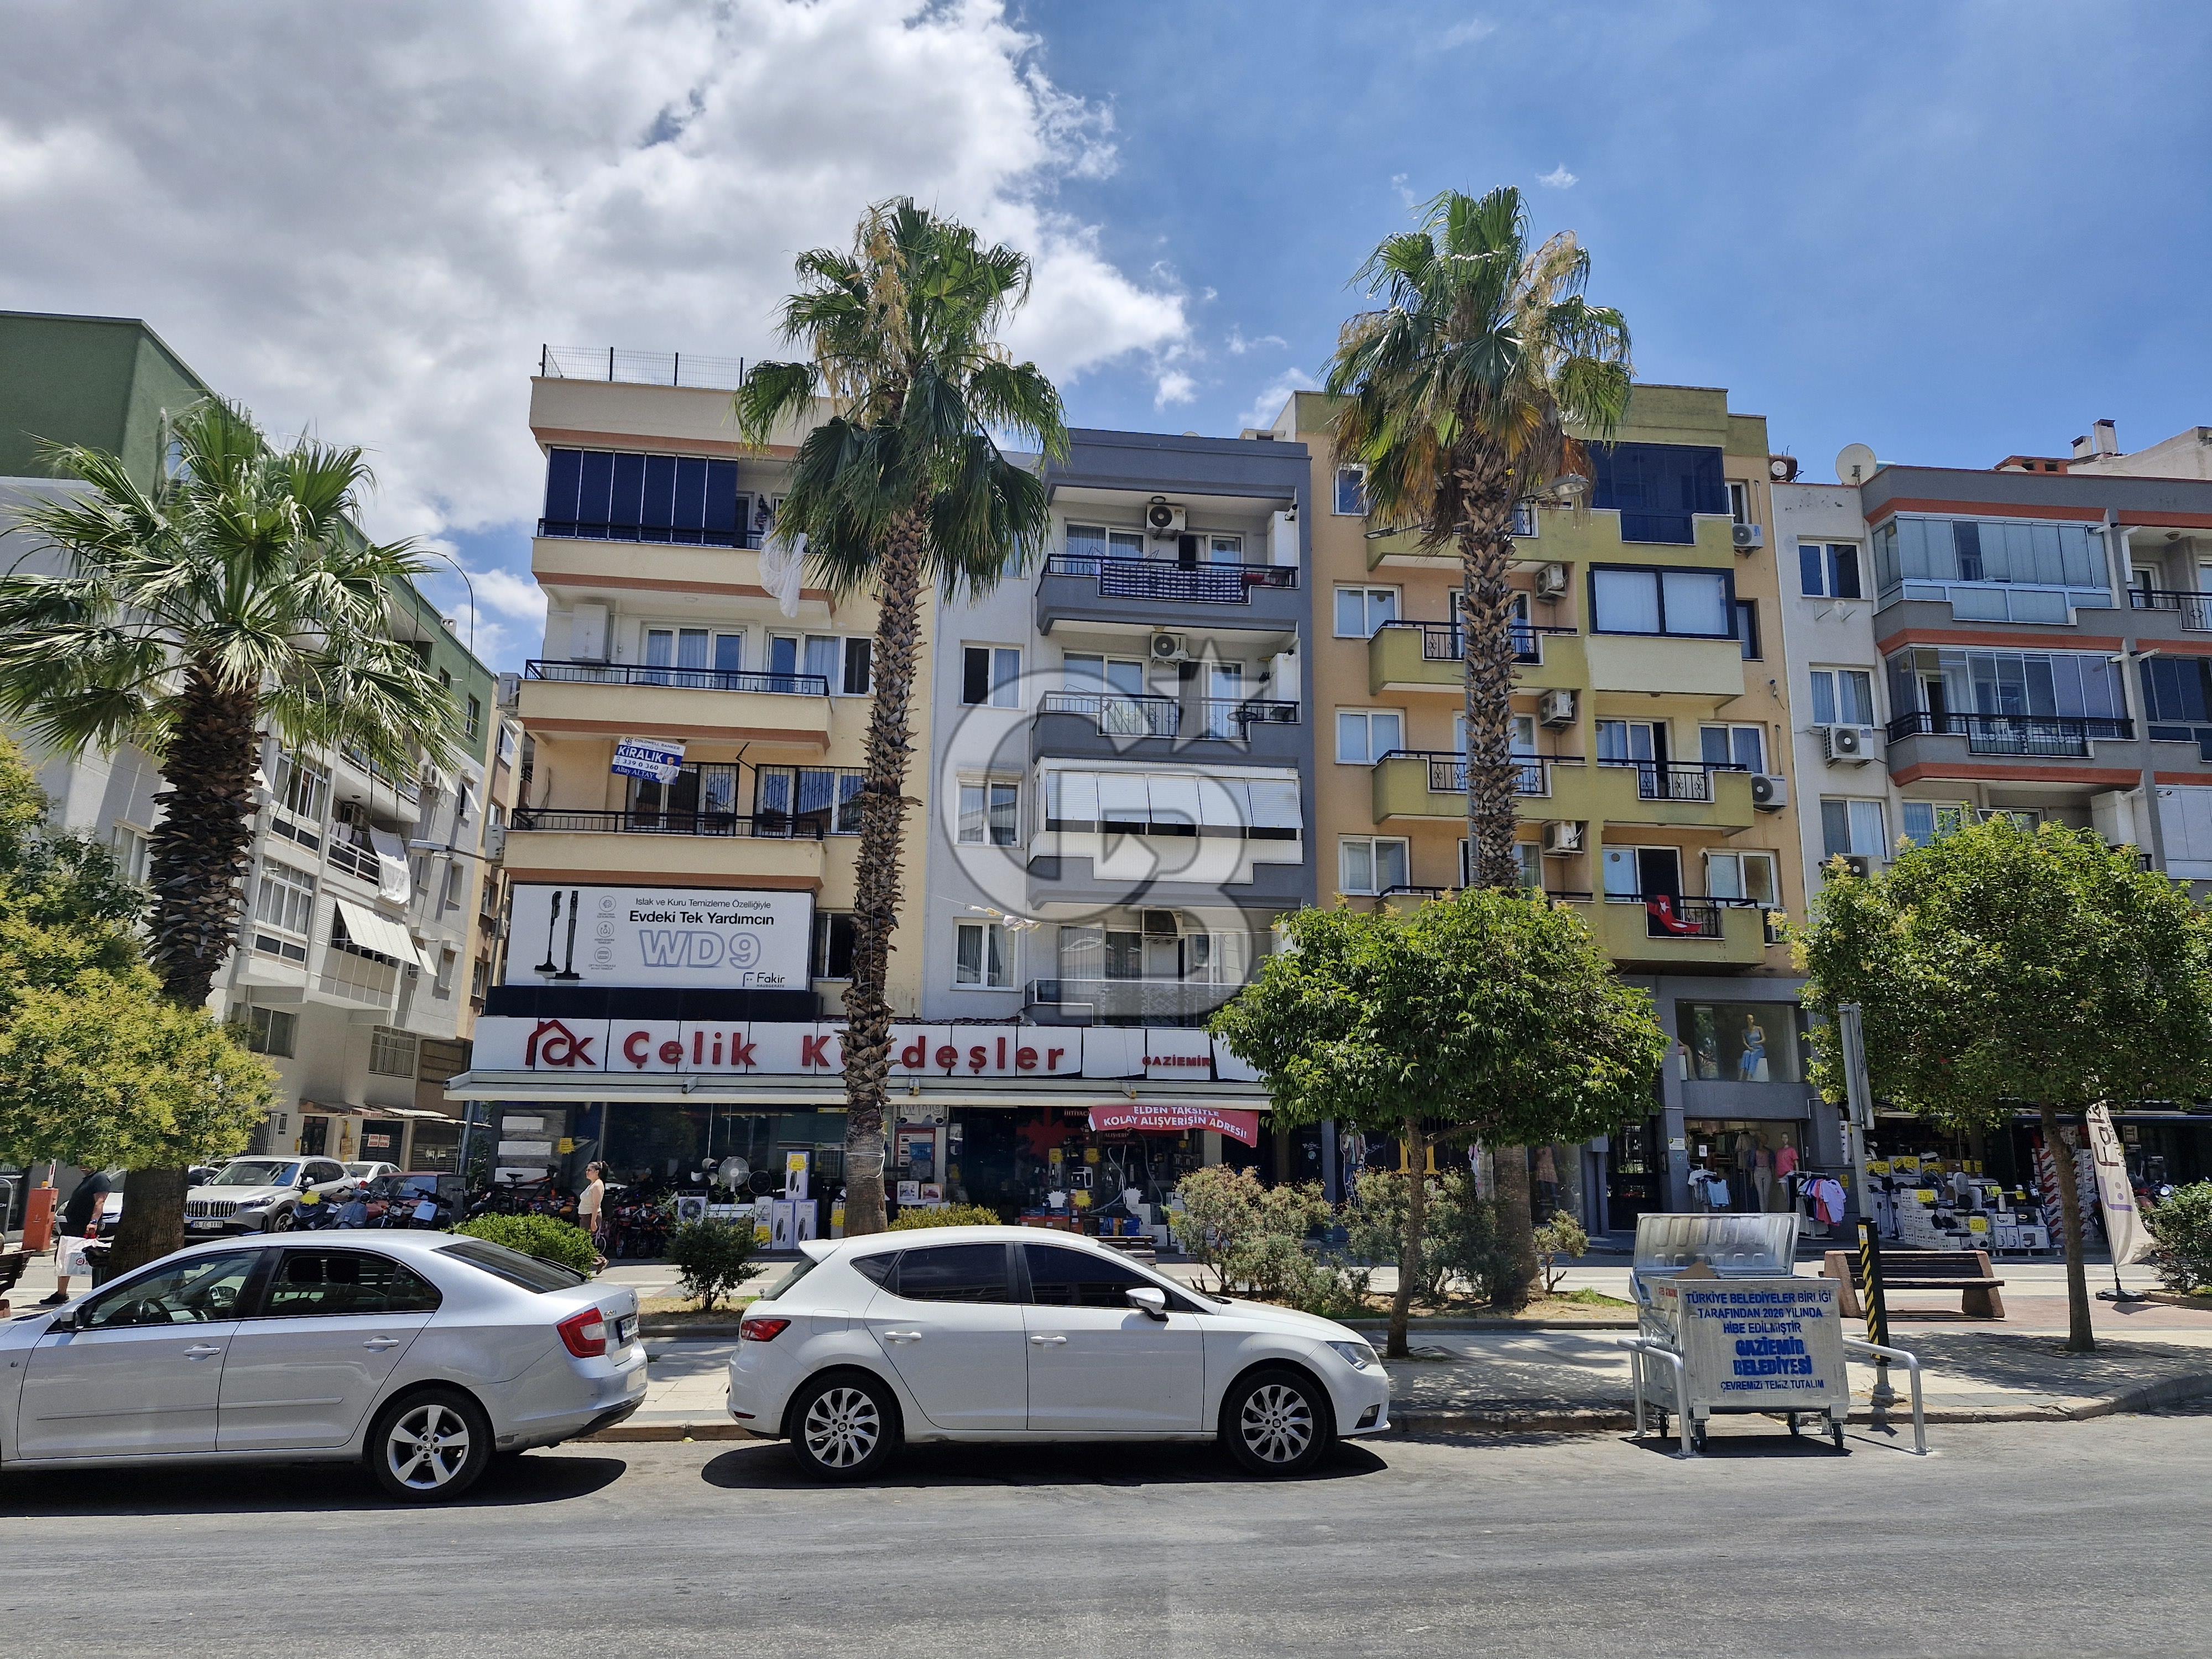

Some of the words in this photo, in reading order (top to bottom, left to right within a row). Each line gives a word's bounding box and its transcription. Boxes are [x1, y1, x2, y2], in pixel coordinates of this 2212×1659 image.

[615, 766, 631, 775] Altay
[632, 769, 655, 779] ALTAY
[688, 899, 730, 907] Temizleme
[732, 899, 771, 910] Özelliğiyle
[630, 910, 675, 923] Evdeki
[680, 912, 703, 924] Tek
[707, 912, 774, 925] Yardımcın
[757, 972, 785, 983] Fakir
[623, 1031, 757, 1069] Çelik
[802, 1035, 1064, 1074] Kdeşler
[1142, 1054, 1211, 1066] GAZİEMİR
[1134, 1106, 1168, 1114] ELDEN
[1171, 1107, 1219, 1117] TAKSİTLE
[1103, 1115, 1138, 1126] KOLAY
[1140, 1114, 1206, 1128] ALIŞVERİŞİN
[1209, 1118, 1247, 1139] ADRESİ!
[1686, 1291, 1727, 1303] TÜRKİYE
[1730, 1291, 1796, 1303] BELEDİYELER
[1798, 1290, 1832, 1302] BİRLİĞİ
[1698, 1308, 1761, 1318] TARAFINDAN
[1786, 1307, 1823, 1318] YILINDA
[1723, 1321, 1746, 1334] HİBE
[1748, 1321, 1802, 1335] EDİLMİŞTİR
[1735, 1336, 1805, 1356] GAZİEMİR
[1733, 1355, 1813, 1375] BELEDİYESİ
[1790, 1379, 1825, 1389] TUTALIM
